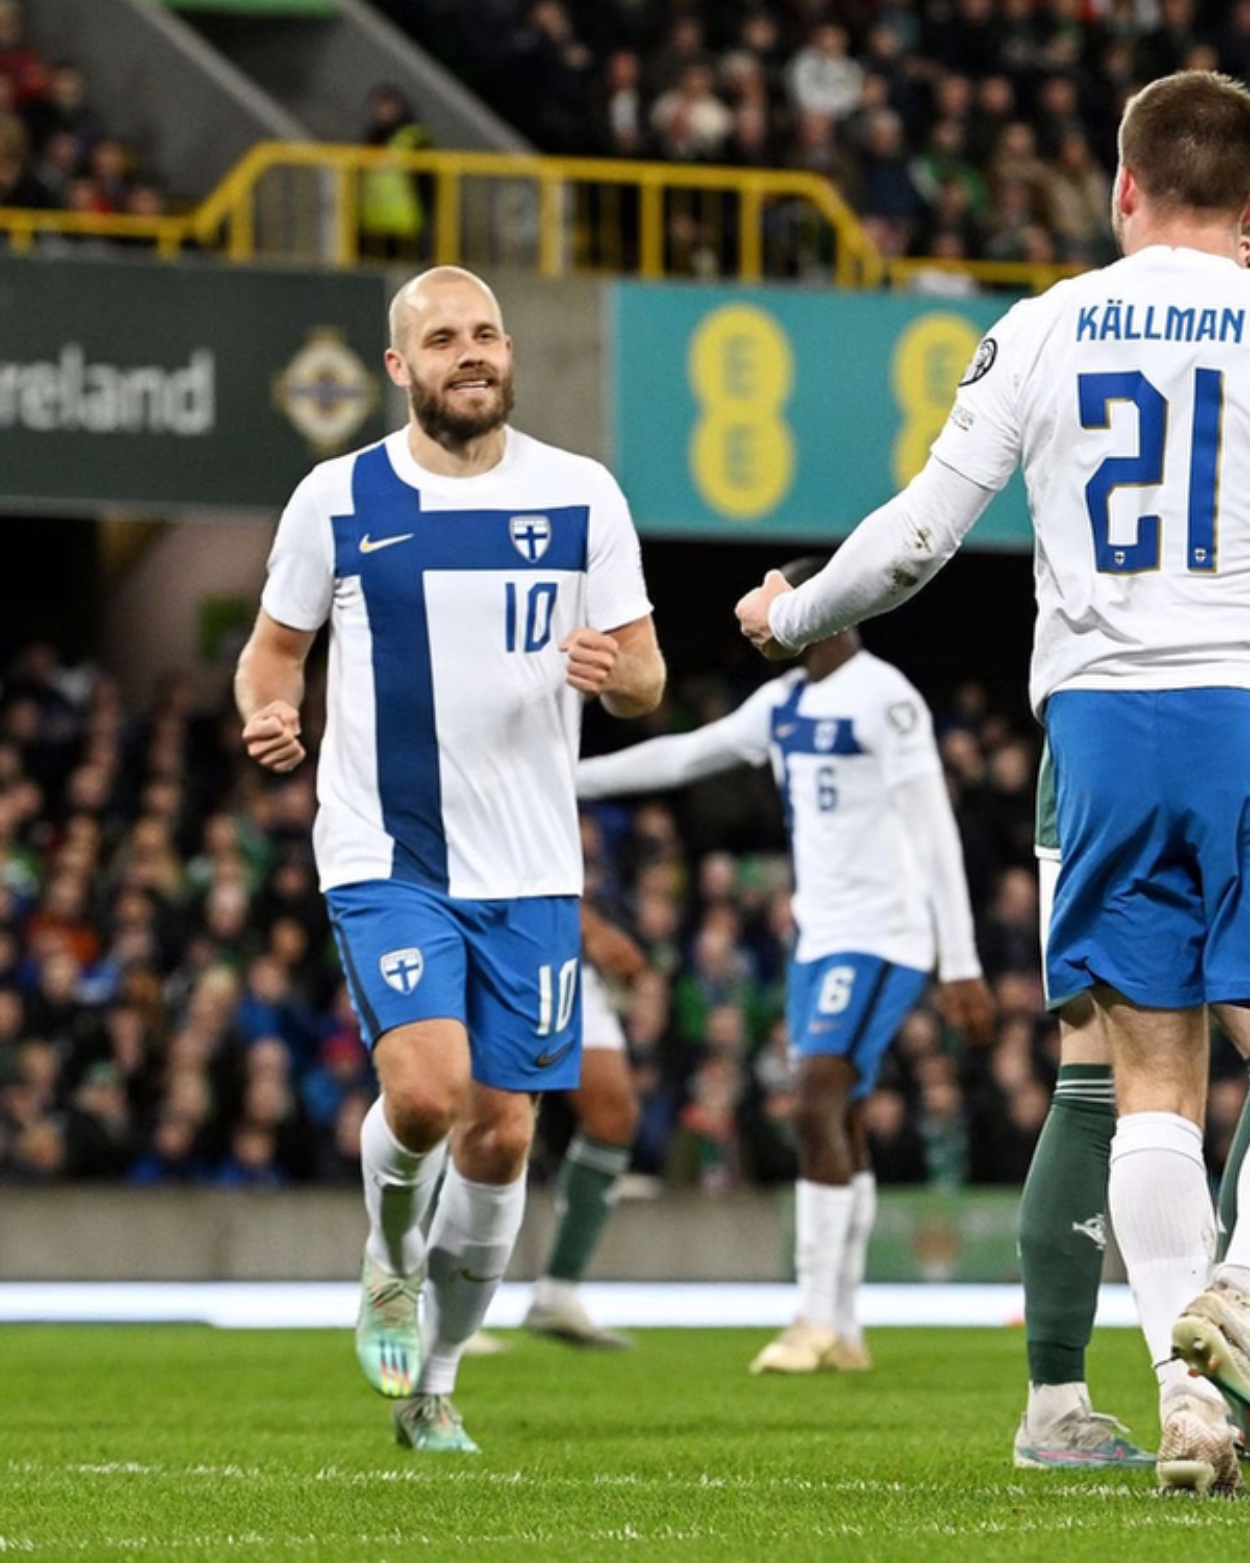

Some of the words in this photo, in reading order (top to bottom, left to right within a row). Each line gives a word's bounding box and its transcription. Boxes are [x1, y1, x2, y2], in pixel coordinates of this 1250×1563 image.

[1076, 299, 1245, 344] KÄLLMAN
[1077, 367, 1225, 575] 21
[505, 582, 559, 653] 10
[817, 765, 839, 812] 6
[535, 957, 579, 1037] 10
[819, 965, 856, 1014] 6
